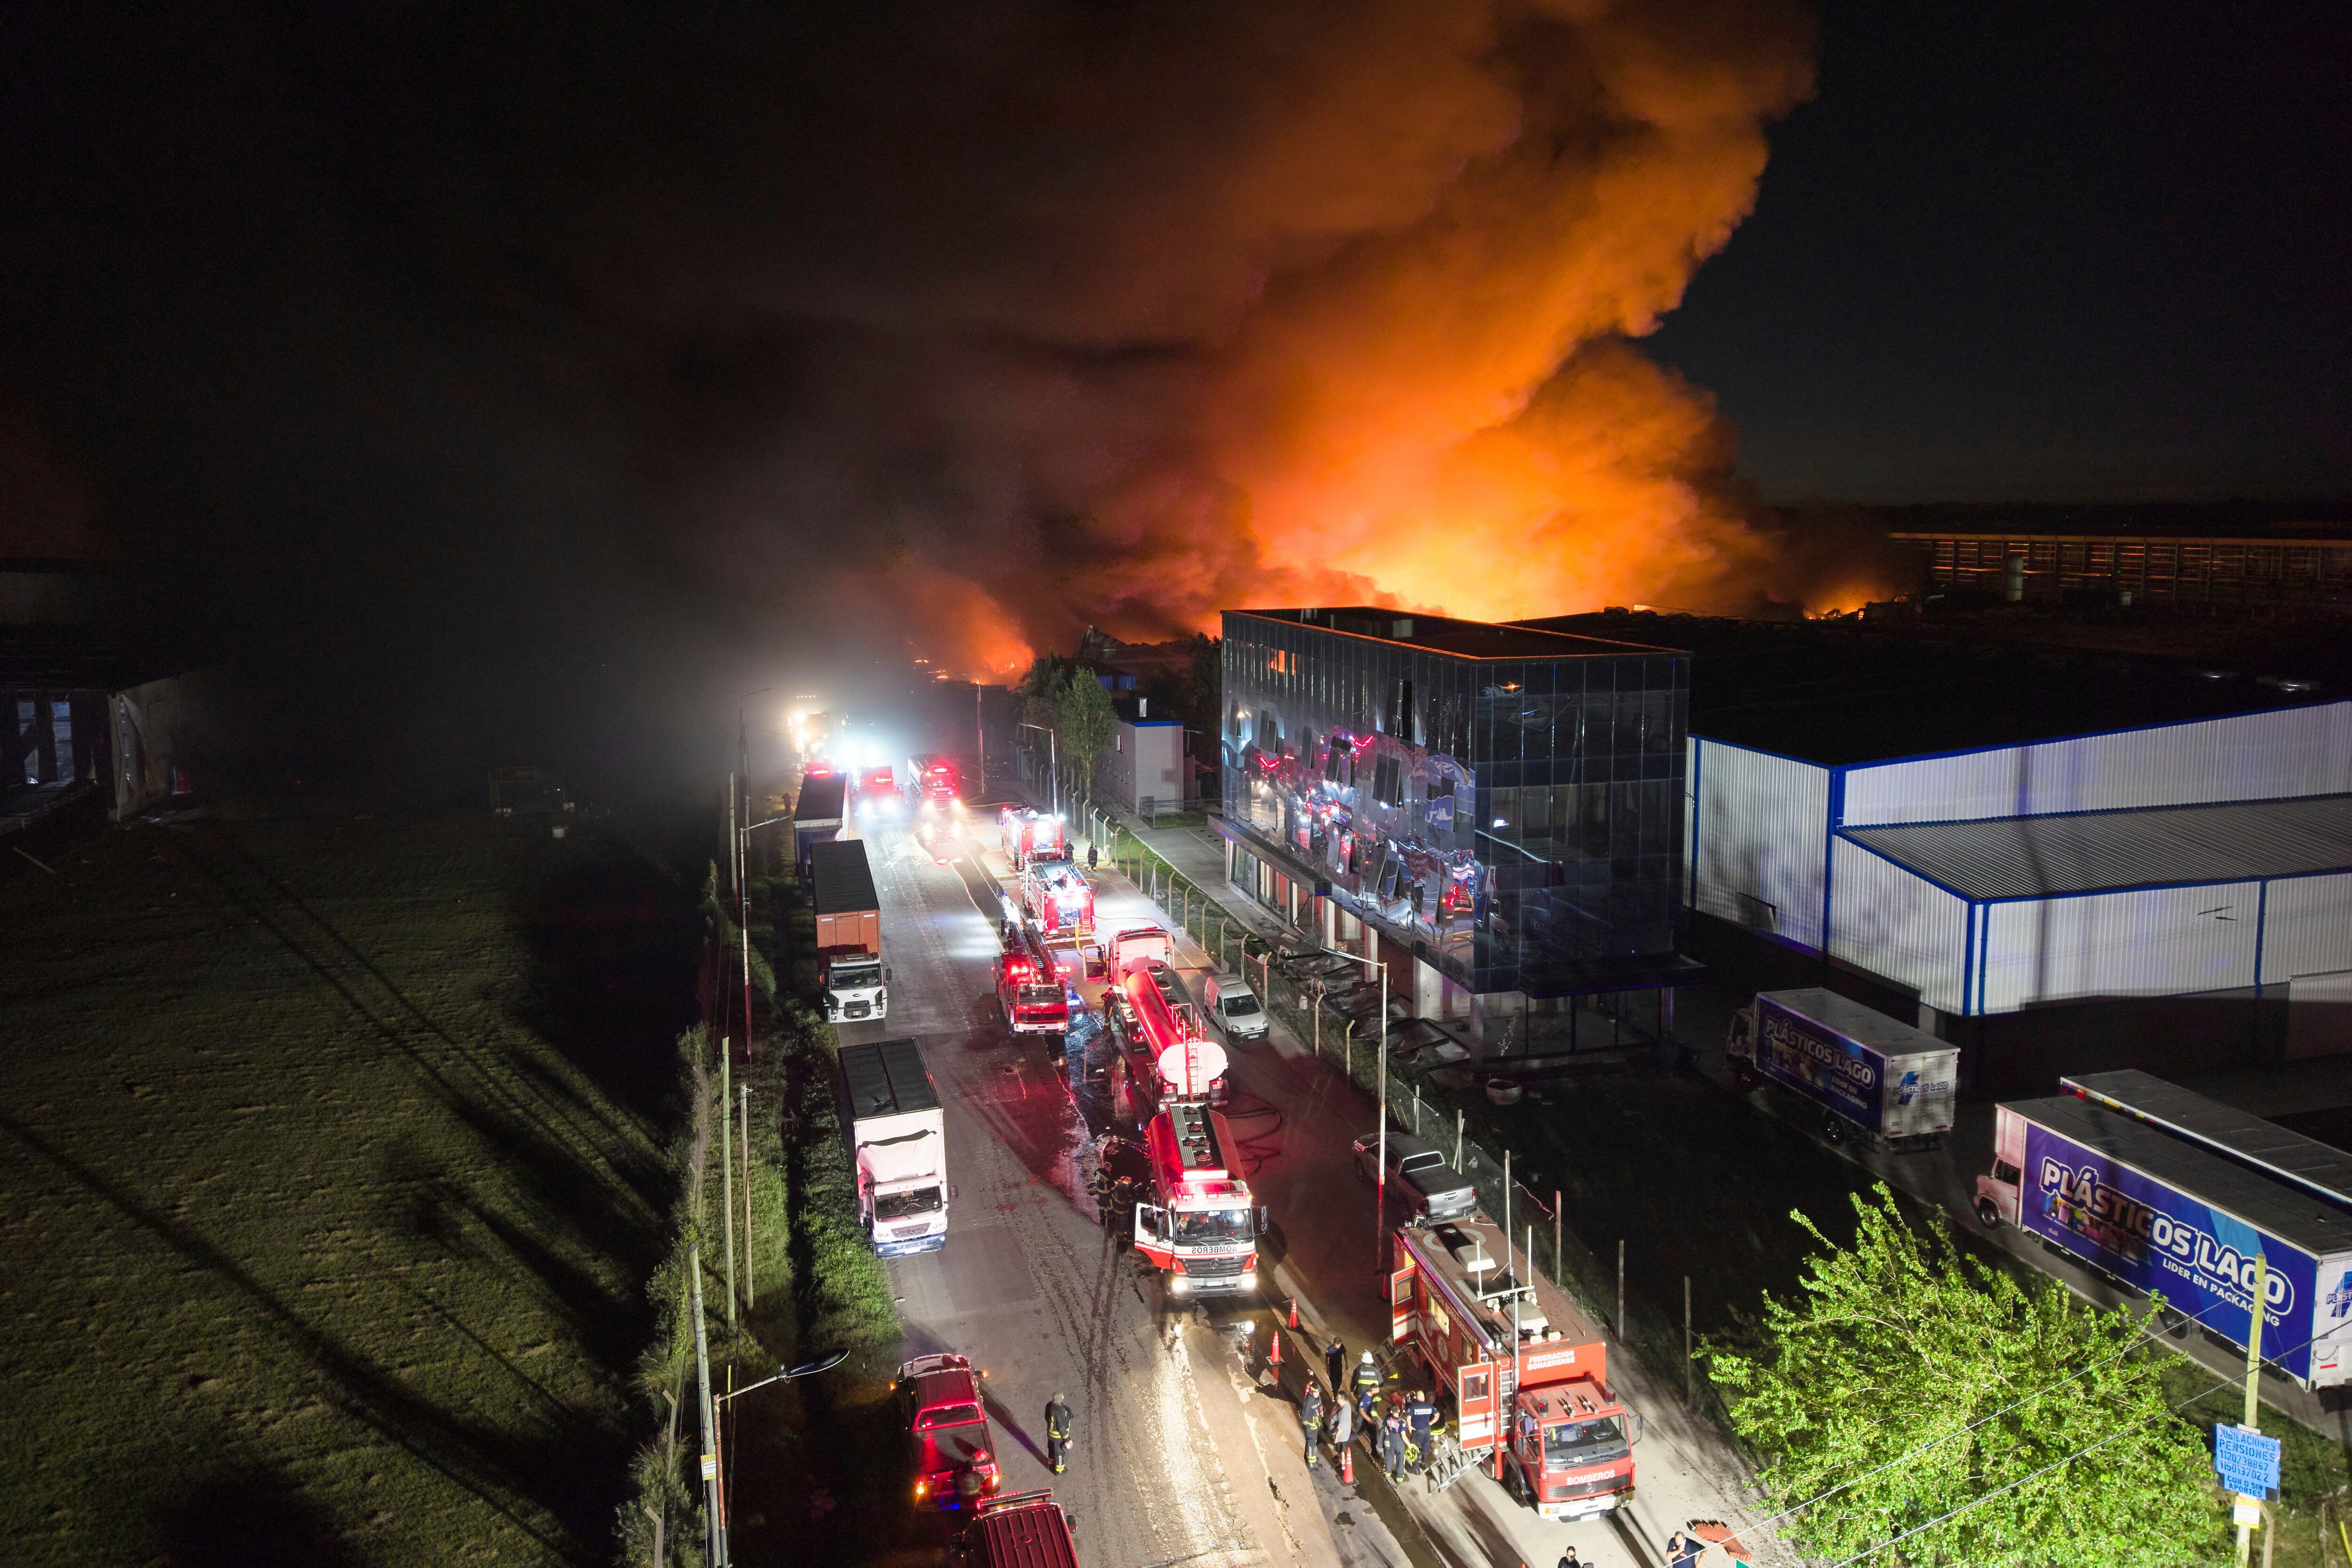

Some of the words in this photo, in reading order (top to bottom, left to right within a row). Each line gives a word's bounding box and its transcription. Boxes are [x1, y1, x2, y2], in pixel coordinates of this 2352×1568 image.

[1766, 1019, 1833, 1064] PLÁSTICOS
[1836, 1053, 1872, 1084] LAGO
[1831, 1084, 1868, 1109] PACKAGING
[1849, 1084, 1858, 1094] EN
[1893, 1084, 1929, 1095] PLÁSTICS
[1930, 1081, 1949, 1091] LAGO
[2043, 1162, 2192, 1257] PLÁSTICOS
[2199, 1240, 2286, 1305] LAGO
[2162, 1258, 2190, 1280] LIDER
[2193, 1274, 2208, 1289] EN
[2209, 1282, 2280, 1327] PACKAGNG
[1527, 1356, 1575, 1371] BONAERENSE
[1529, 1349, 1574, 1363] FEDERACION
[2219, 1427, 2276, 1452] JUBILACIONES
[2219, 1439, 2275, 1463] PENSIONES
[2219, 1449, 2269, 1471] 1120738867
[1566, 1469, 1615, 1486] BOMBEROS
[2220, 1460, 2269, 1483] 1150137022
[2227, 1475, 2242, 1484] CON
[2251, 1482, 2263, 1491] SIN
[2229, 1483, 2262, 1497] APORTES
